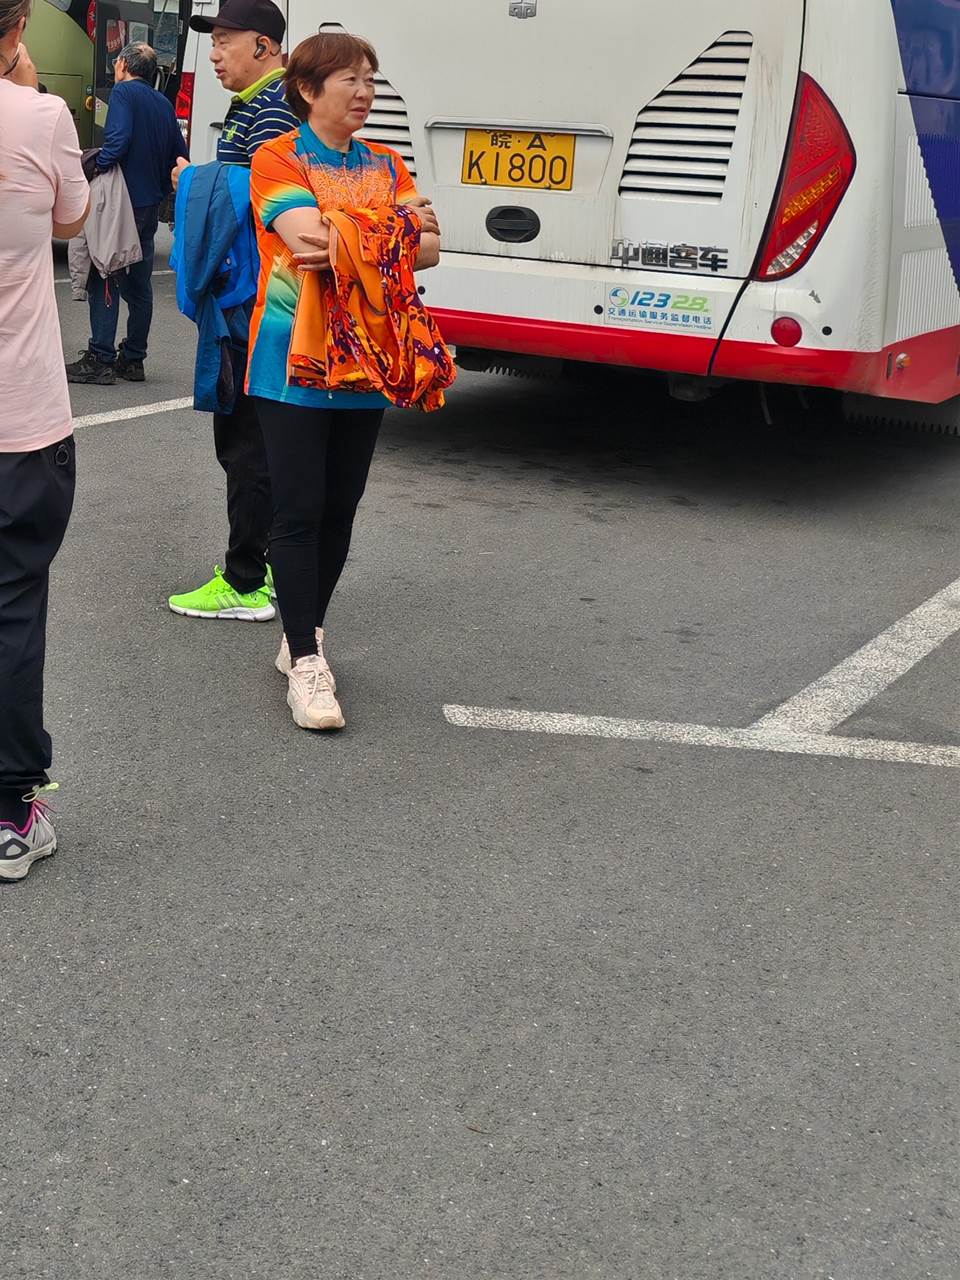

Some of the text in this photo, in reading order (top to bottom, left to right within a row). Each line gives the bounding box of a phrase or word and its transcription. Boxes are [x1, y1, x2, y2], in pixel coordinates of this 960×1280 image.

[467, 150, 568, 185] K1800
[607, 307, 712, 325] 交通运输服务监督电话
